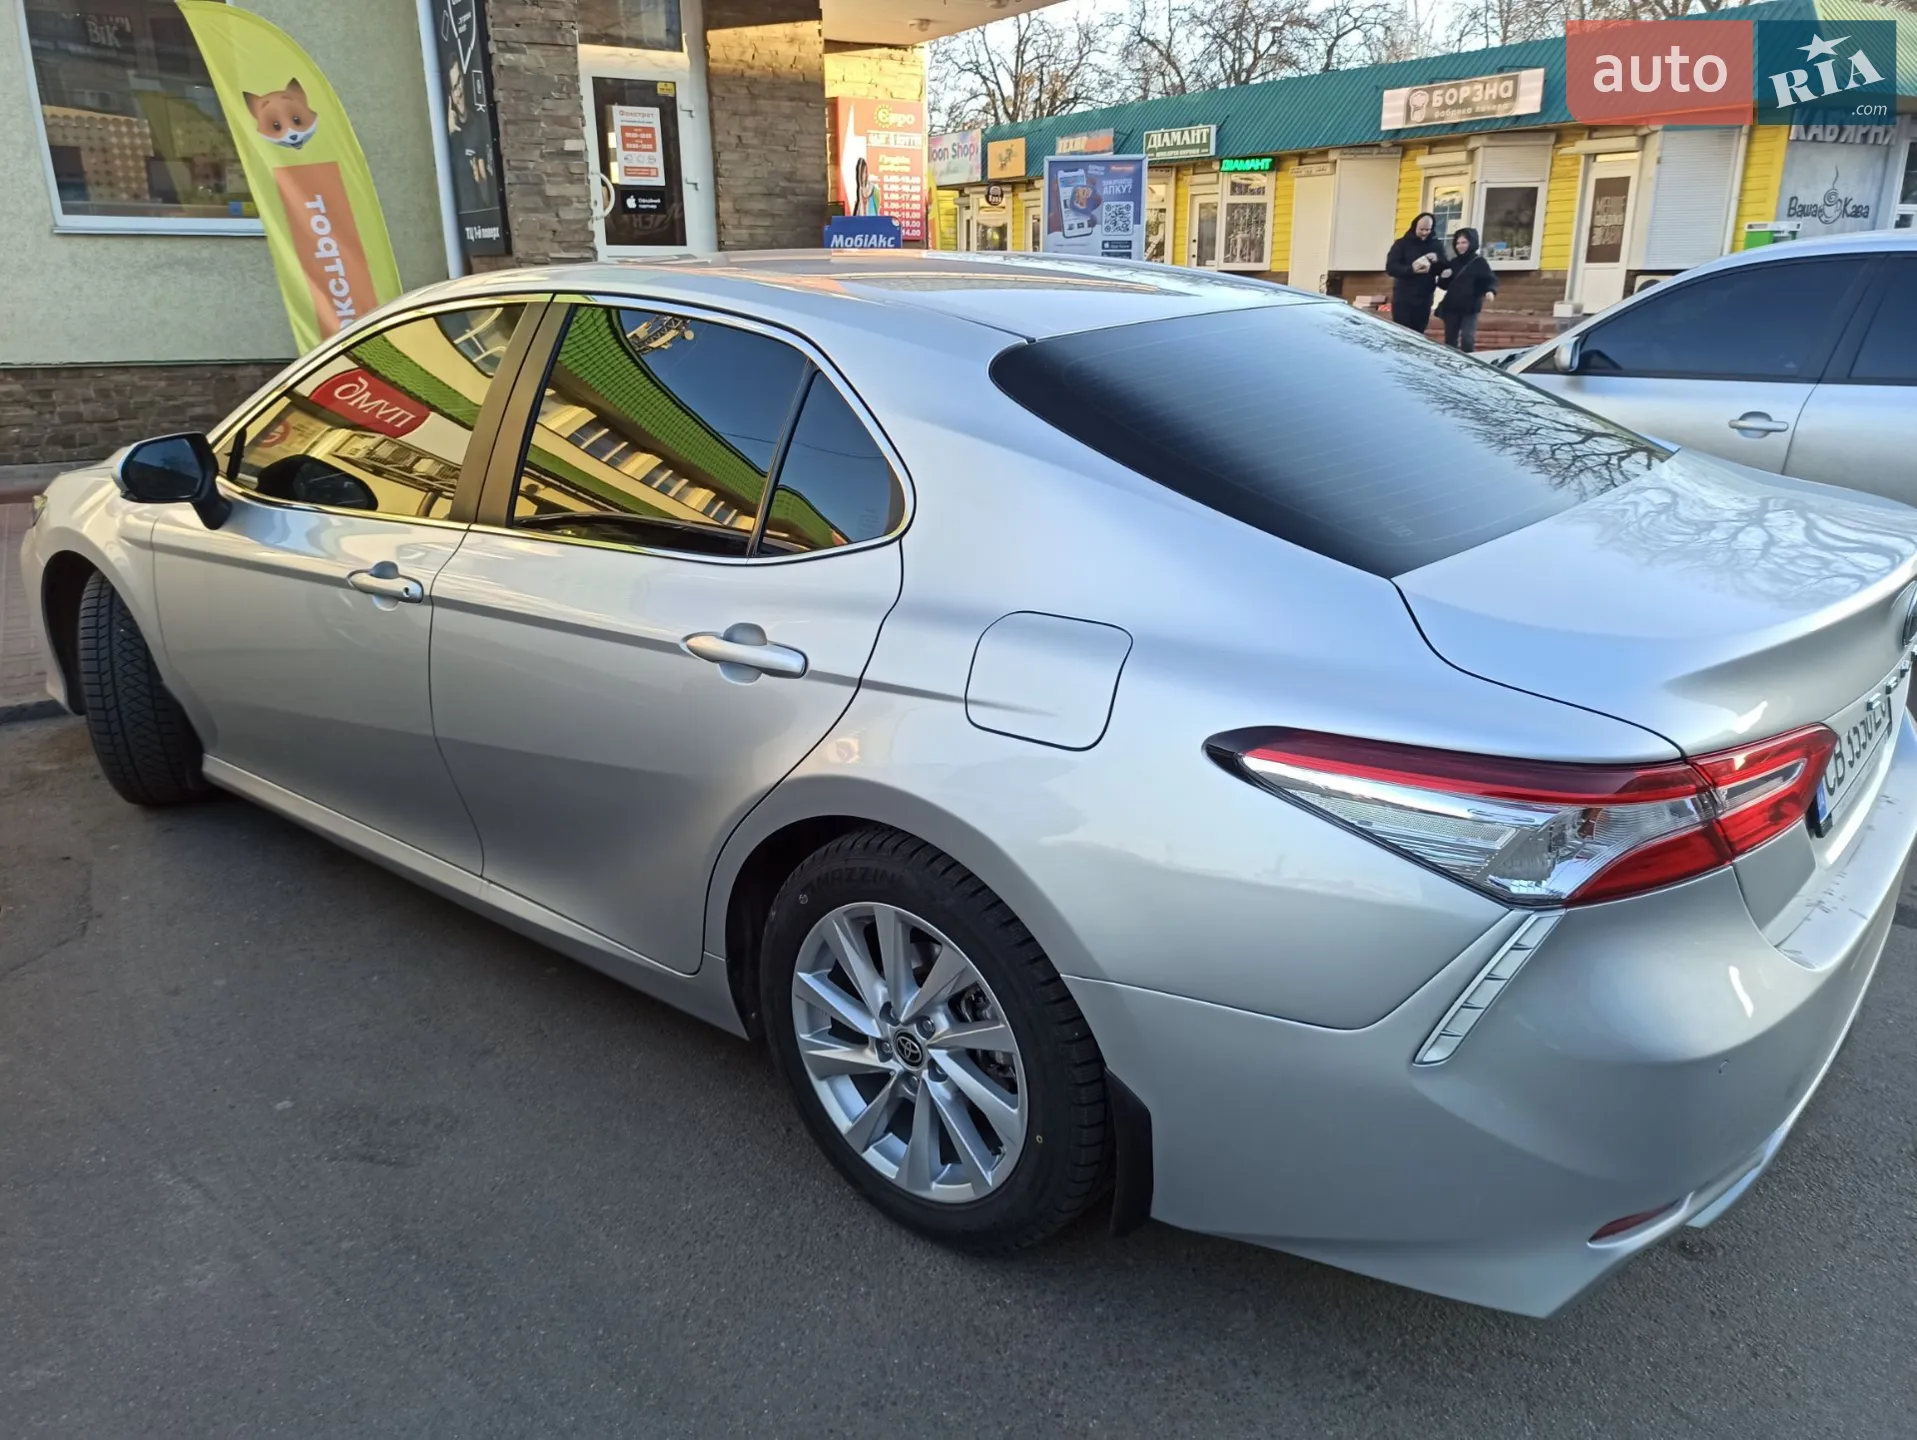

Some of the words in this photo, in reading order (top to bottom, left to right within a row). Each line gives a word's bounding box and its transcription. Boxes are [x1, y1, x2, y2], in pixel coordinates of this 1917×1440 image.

[1146, 128, 1210, 150] ДІАМАНТ
[1220, 158, 1273, 171] ДІАМАНТ
[1102, 184, 1132, 195] АПКУ?
[1787, 195, 1819, 218] Ваша
